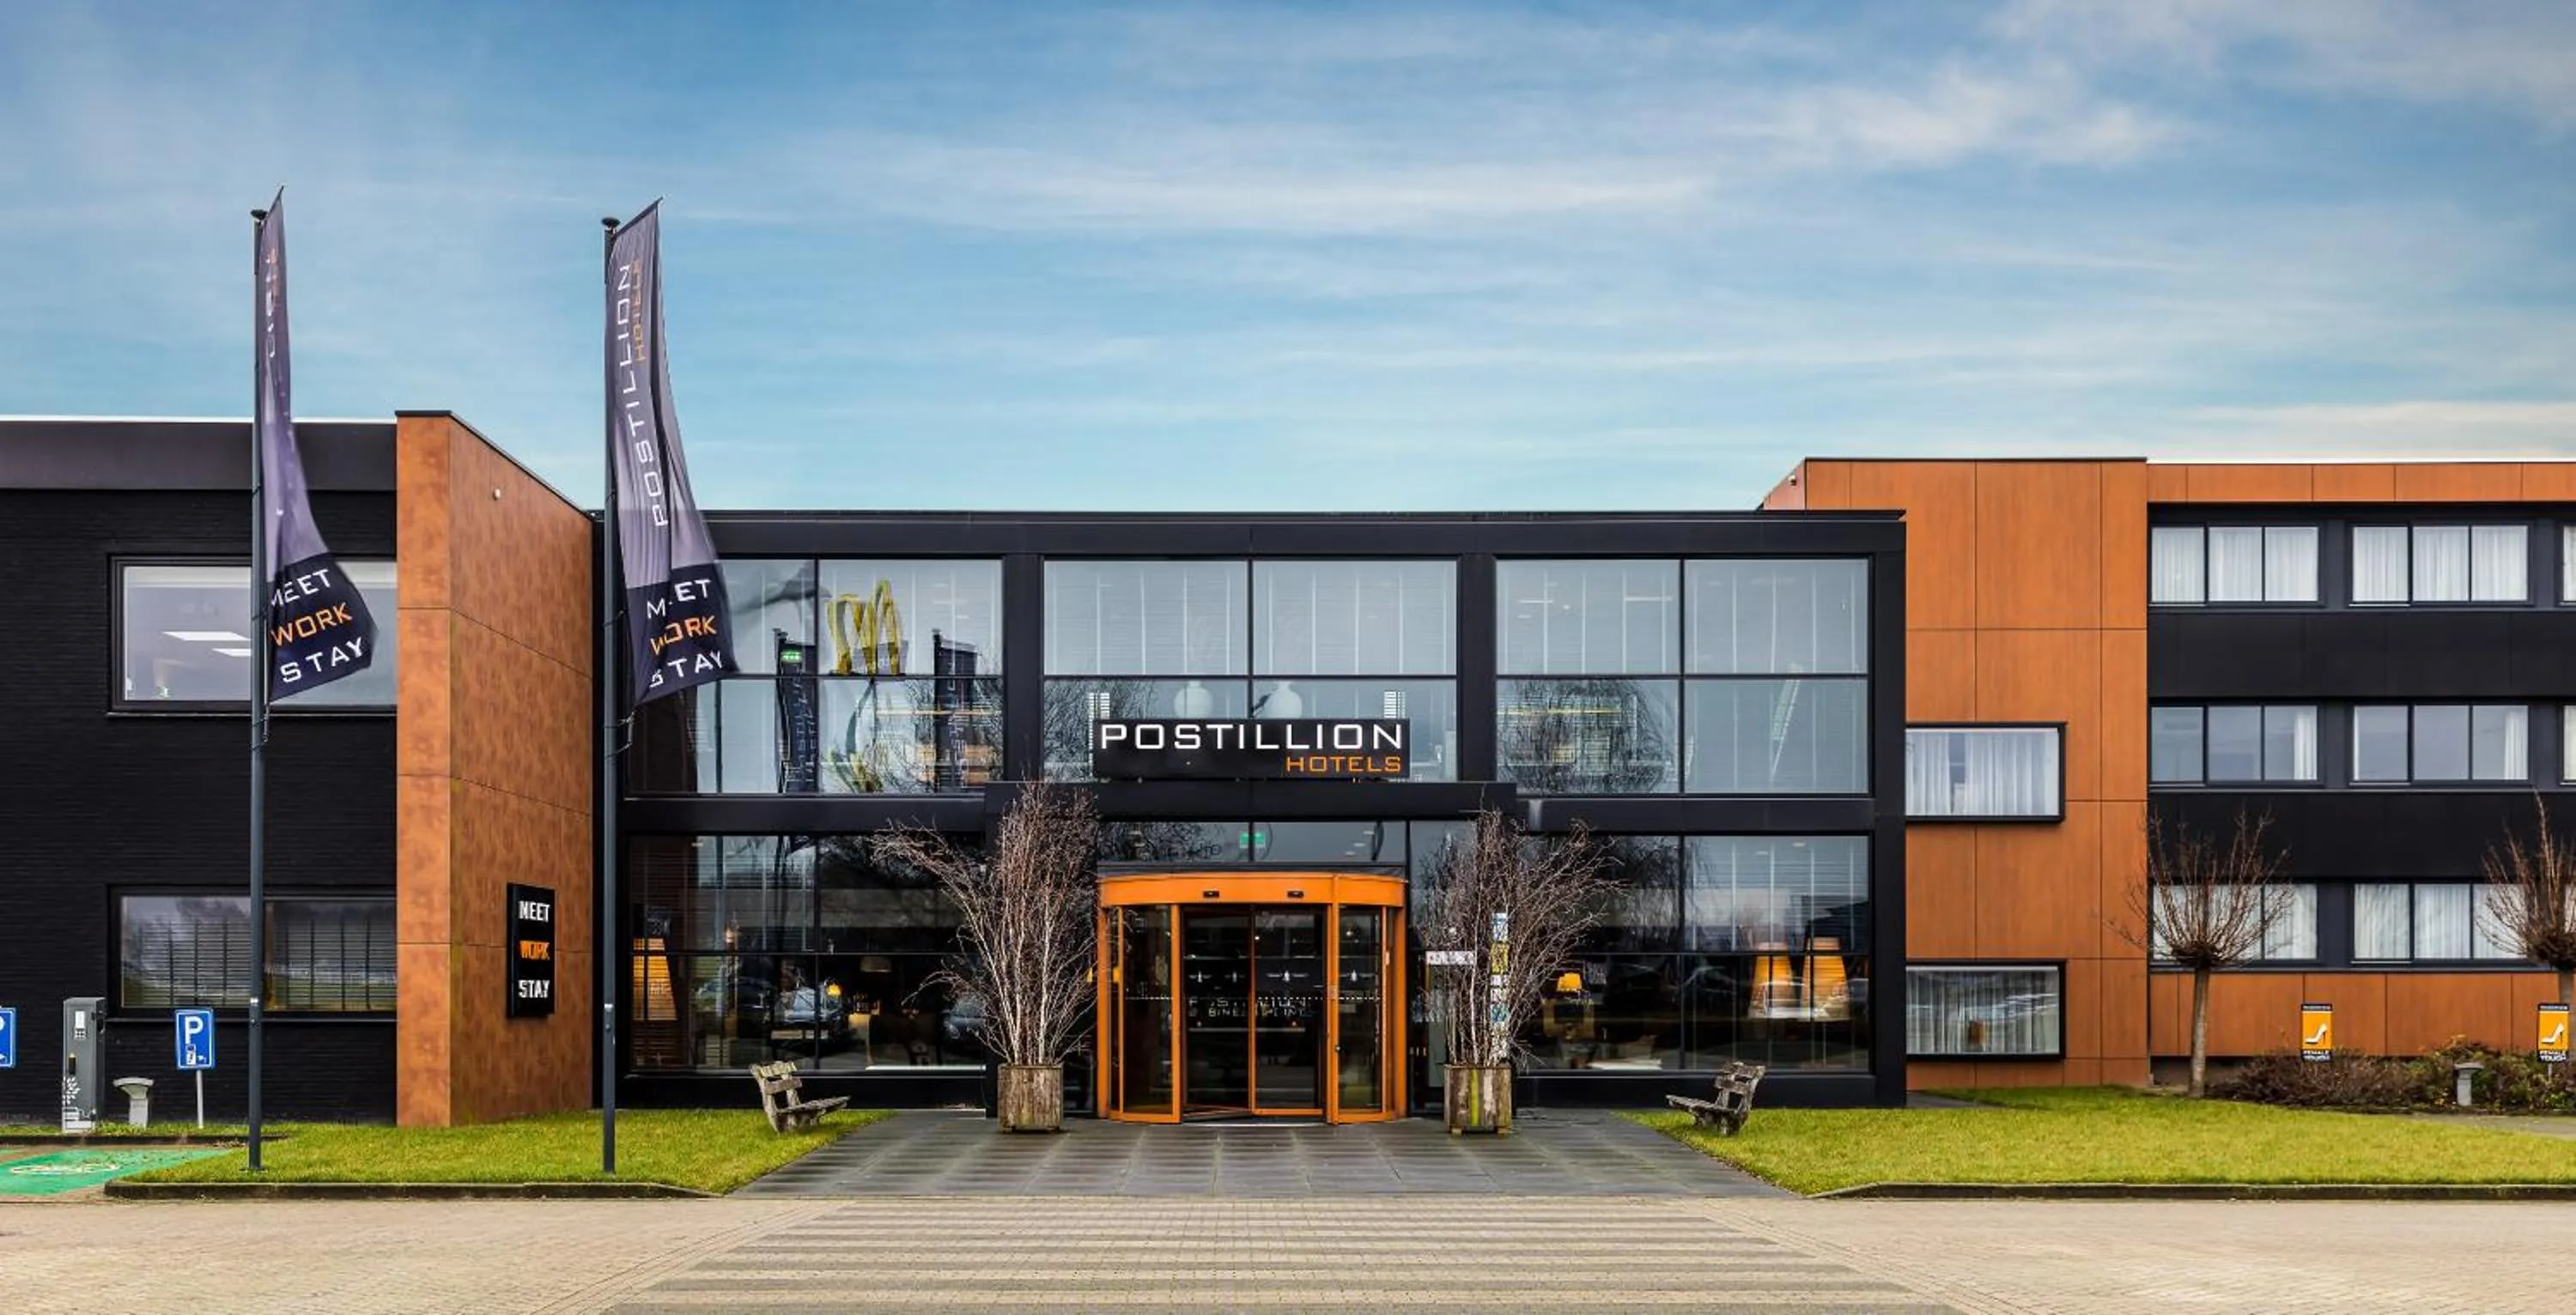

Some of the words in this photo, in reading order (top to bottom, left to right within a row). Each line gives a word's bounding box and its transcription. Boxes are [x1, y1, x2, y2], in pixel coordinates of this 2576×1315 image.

[617, 264, 669, 527] POSTILLION
[270, 568, 331, 607] MEET
[647, 579, 712, 619] MET
[270, 602, 353, 646] WORK
[280, 636, 362, 683] STAY
[1101, 724, 1402, 749] POSTILLION
[1285, 756, 1402, 773] HOTELS
[519, 900, 550, 923] MEET
[519, 940, 550, 960] WORK
[518, 979, 550, 999] STAY
[184, 1015, 204, 1045] P
